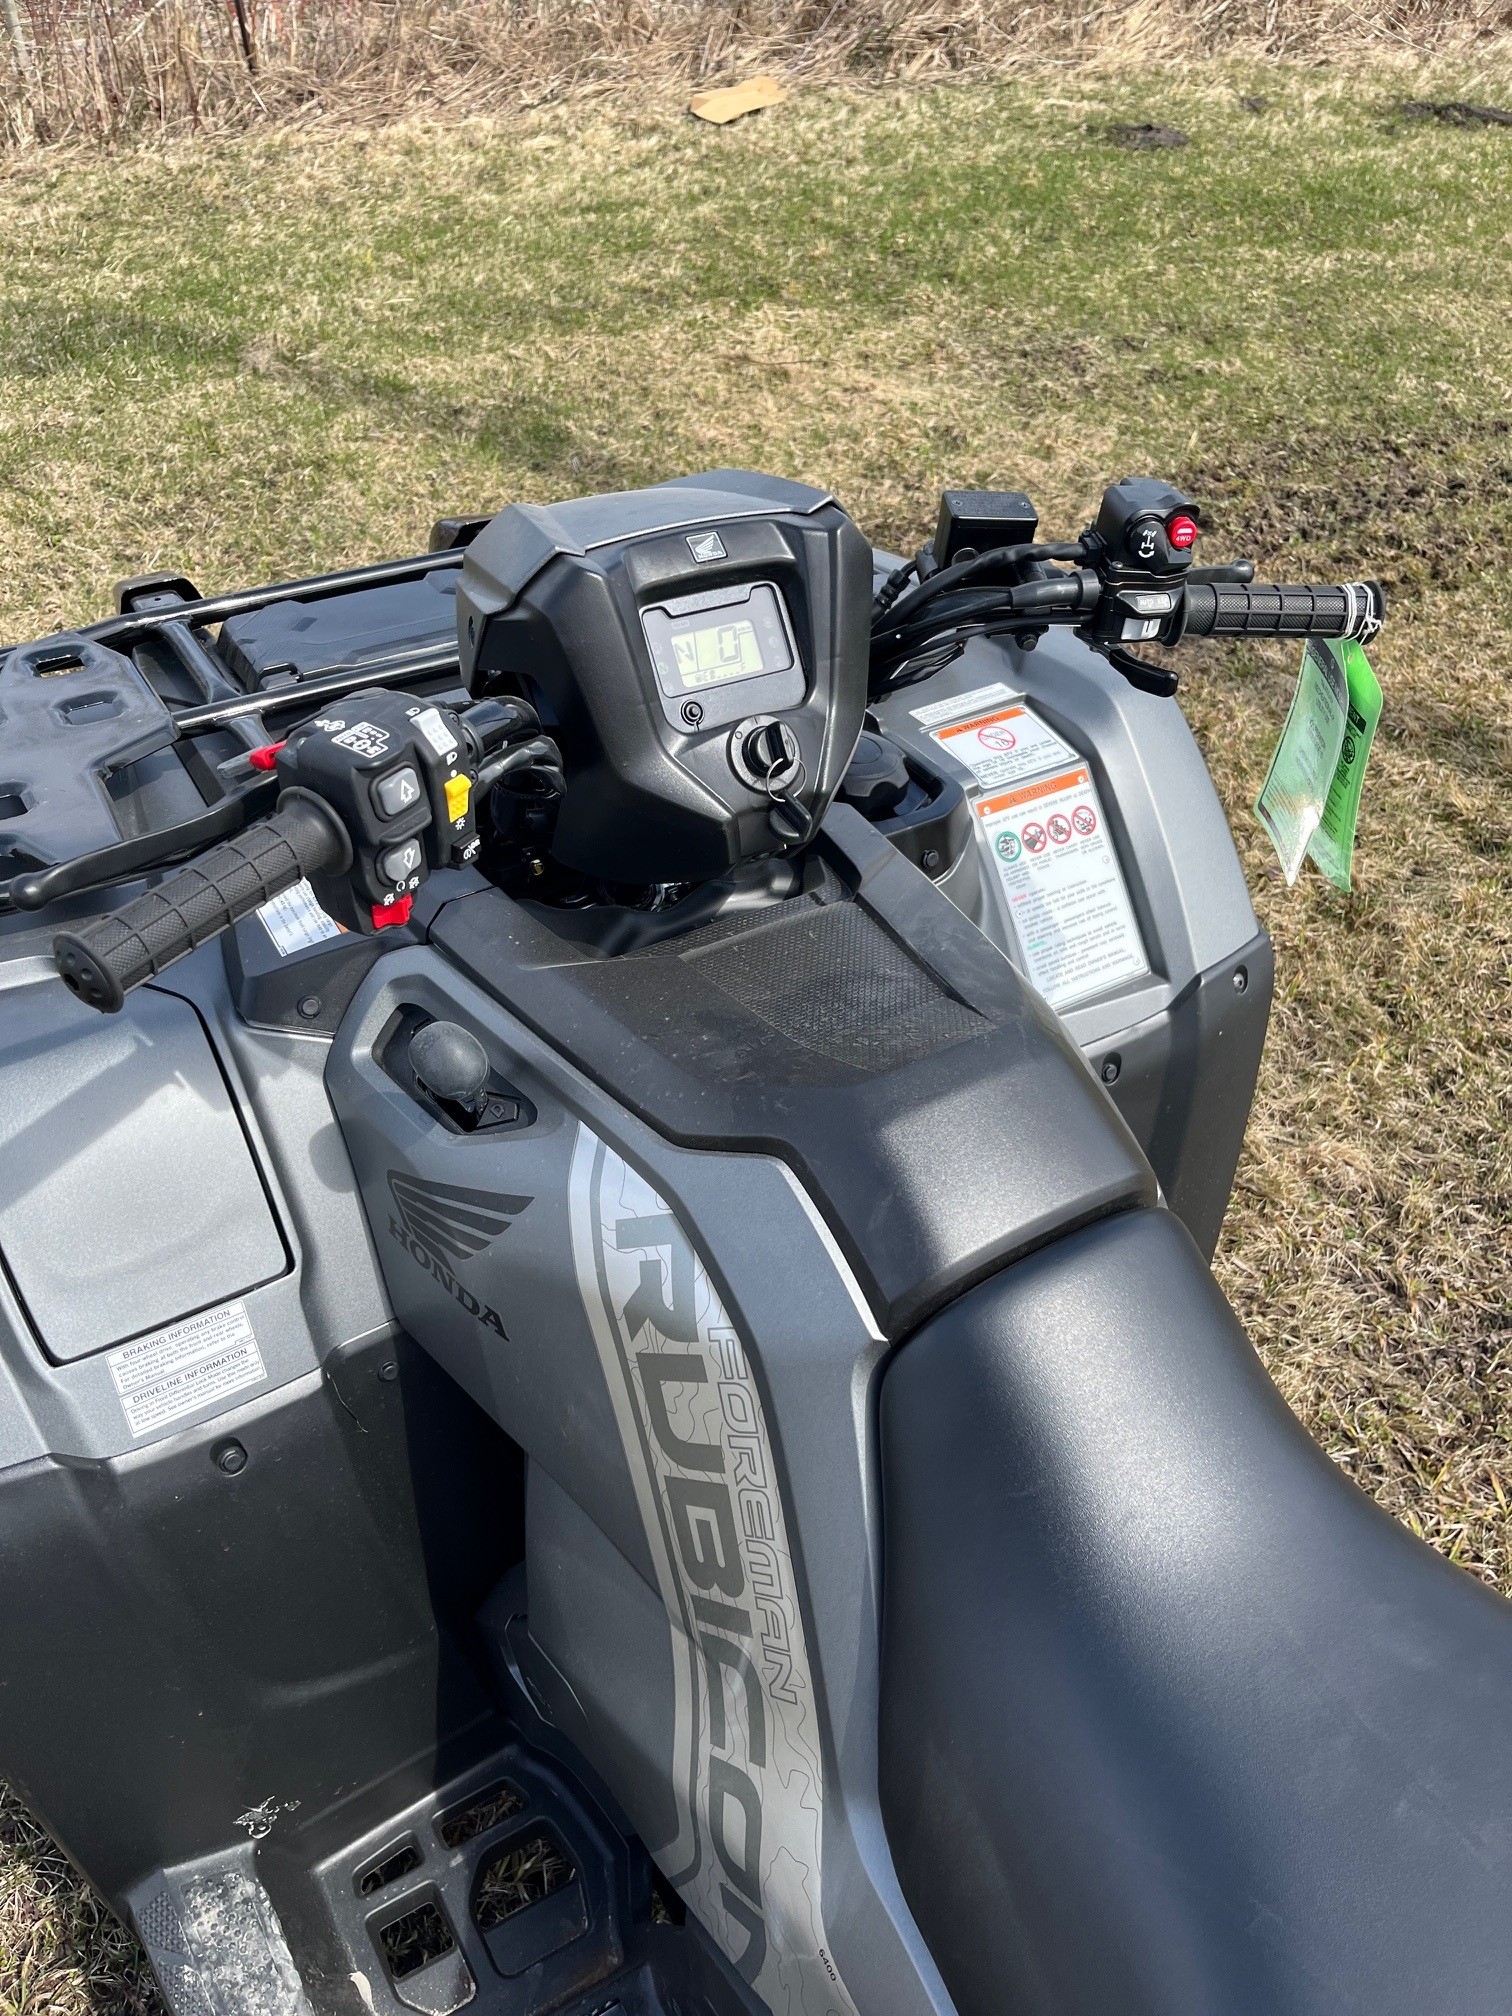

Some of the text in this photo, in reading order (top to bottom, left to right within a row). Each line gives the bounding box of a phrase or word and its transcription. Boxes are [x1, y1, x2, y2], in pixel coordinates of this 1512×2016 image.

[698, 550, 724, 559] HONDA
[674, 625, 740, 664] N 0
[963, 716, 999, 731] WARNING
[1019, 781, 1057, 800] WARNING
[387, 1213, 511, 1342] HONDA
[123, 1310, 230, 1359] BRAKING INFORMATION
[133, 1348, 247, 1403] DRIVELINE INFORMATION
[707, 1327, 797, 1705] FOREMAN
[615, 1213, 767, 1985] RUBICON
[819, 1949, 836, 1981] 6400
